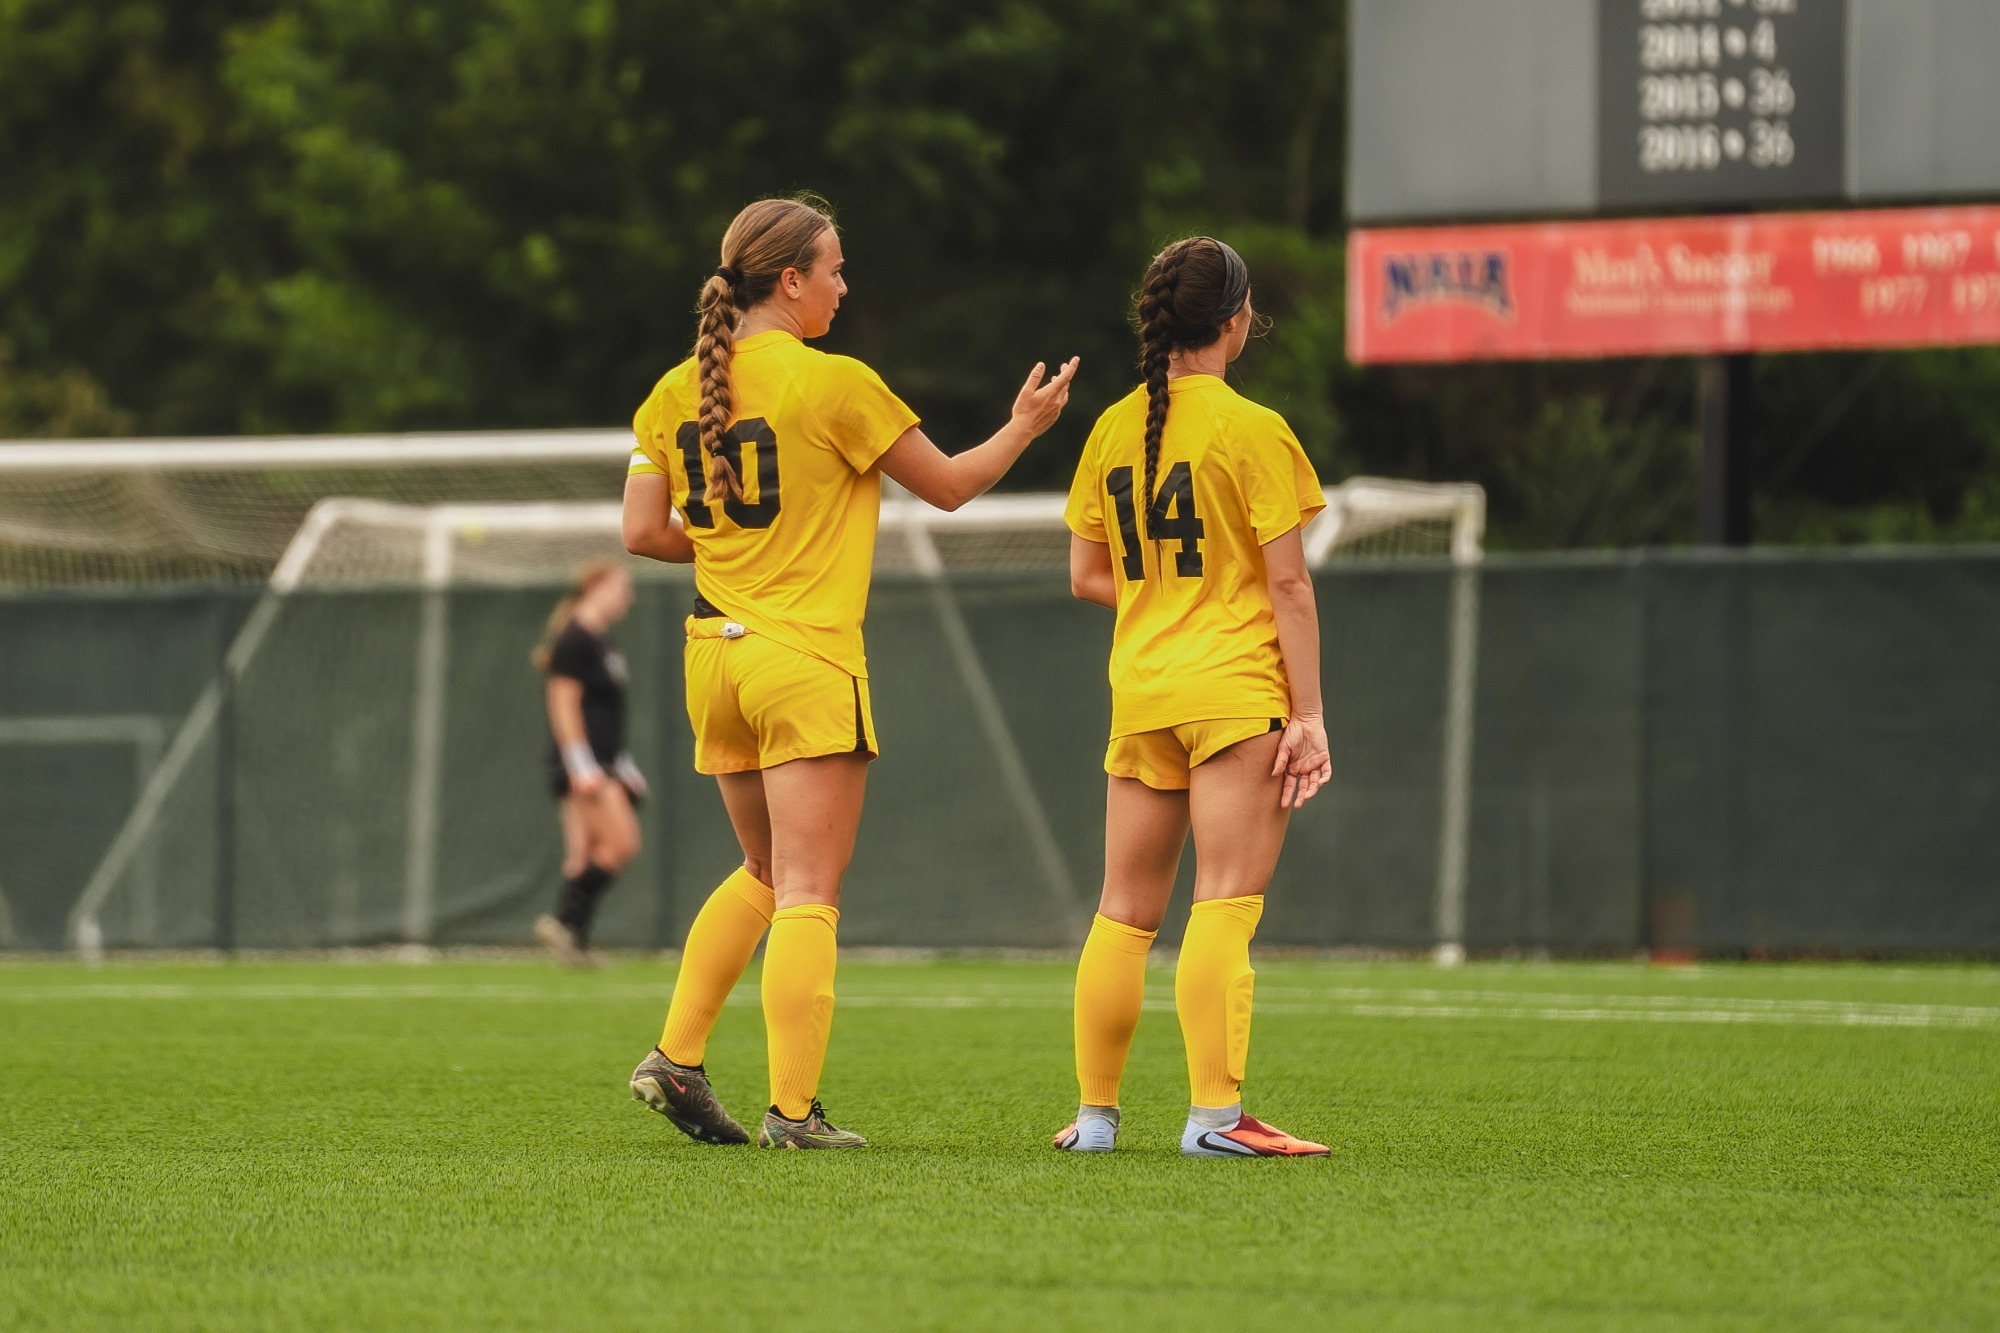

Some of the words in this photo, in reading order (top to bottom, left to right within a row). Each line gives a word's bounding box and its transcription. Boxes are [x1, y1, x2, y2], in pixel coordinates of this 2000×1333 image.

[1640, 22, 1720, 70] 2014
[1751, 17, 1776, 64] 4
[1639, 72, 1720, 120] 2015
[1750, 66, 1796, 118] 36
[1639, 123, 1720, 171] 2016
[1750, 117, 1796, 169] 36
[1384, 251, 1514, 318] NAIA
[676, 416, 782, 529] 10
[1106, 461, 1205, 581] 14
